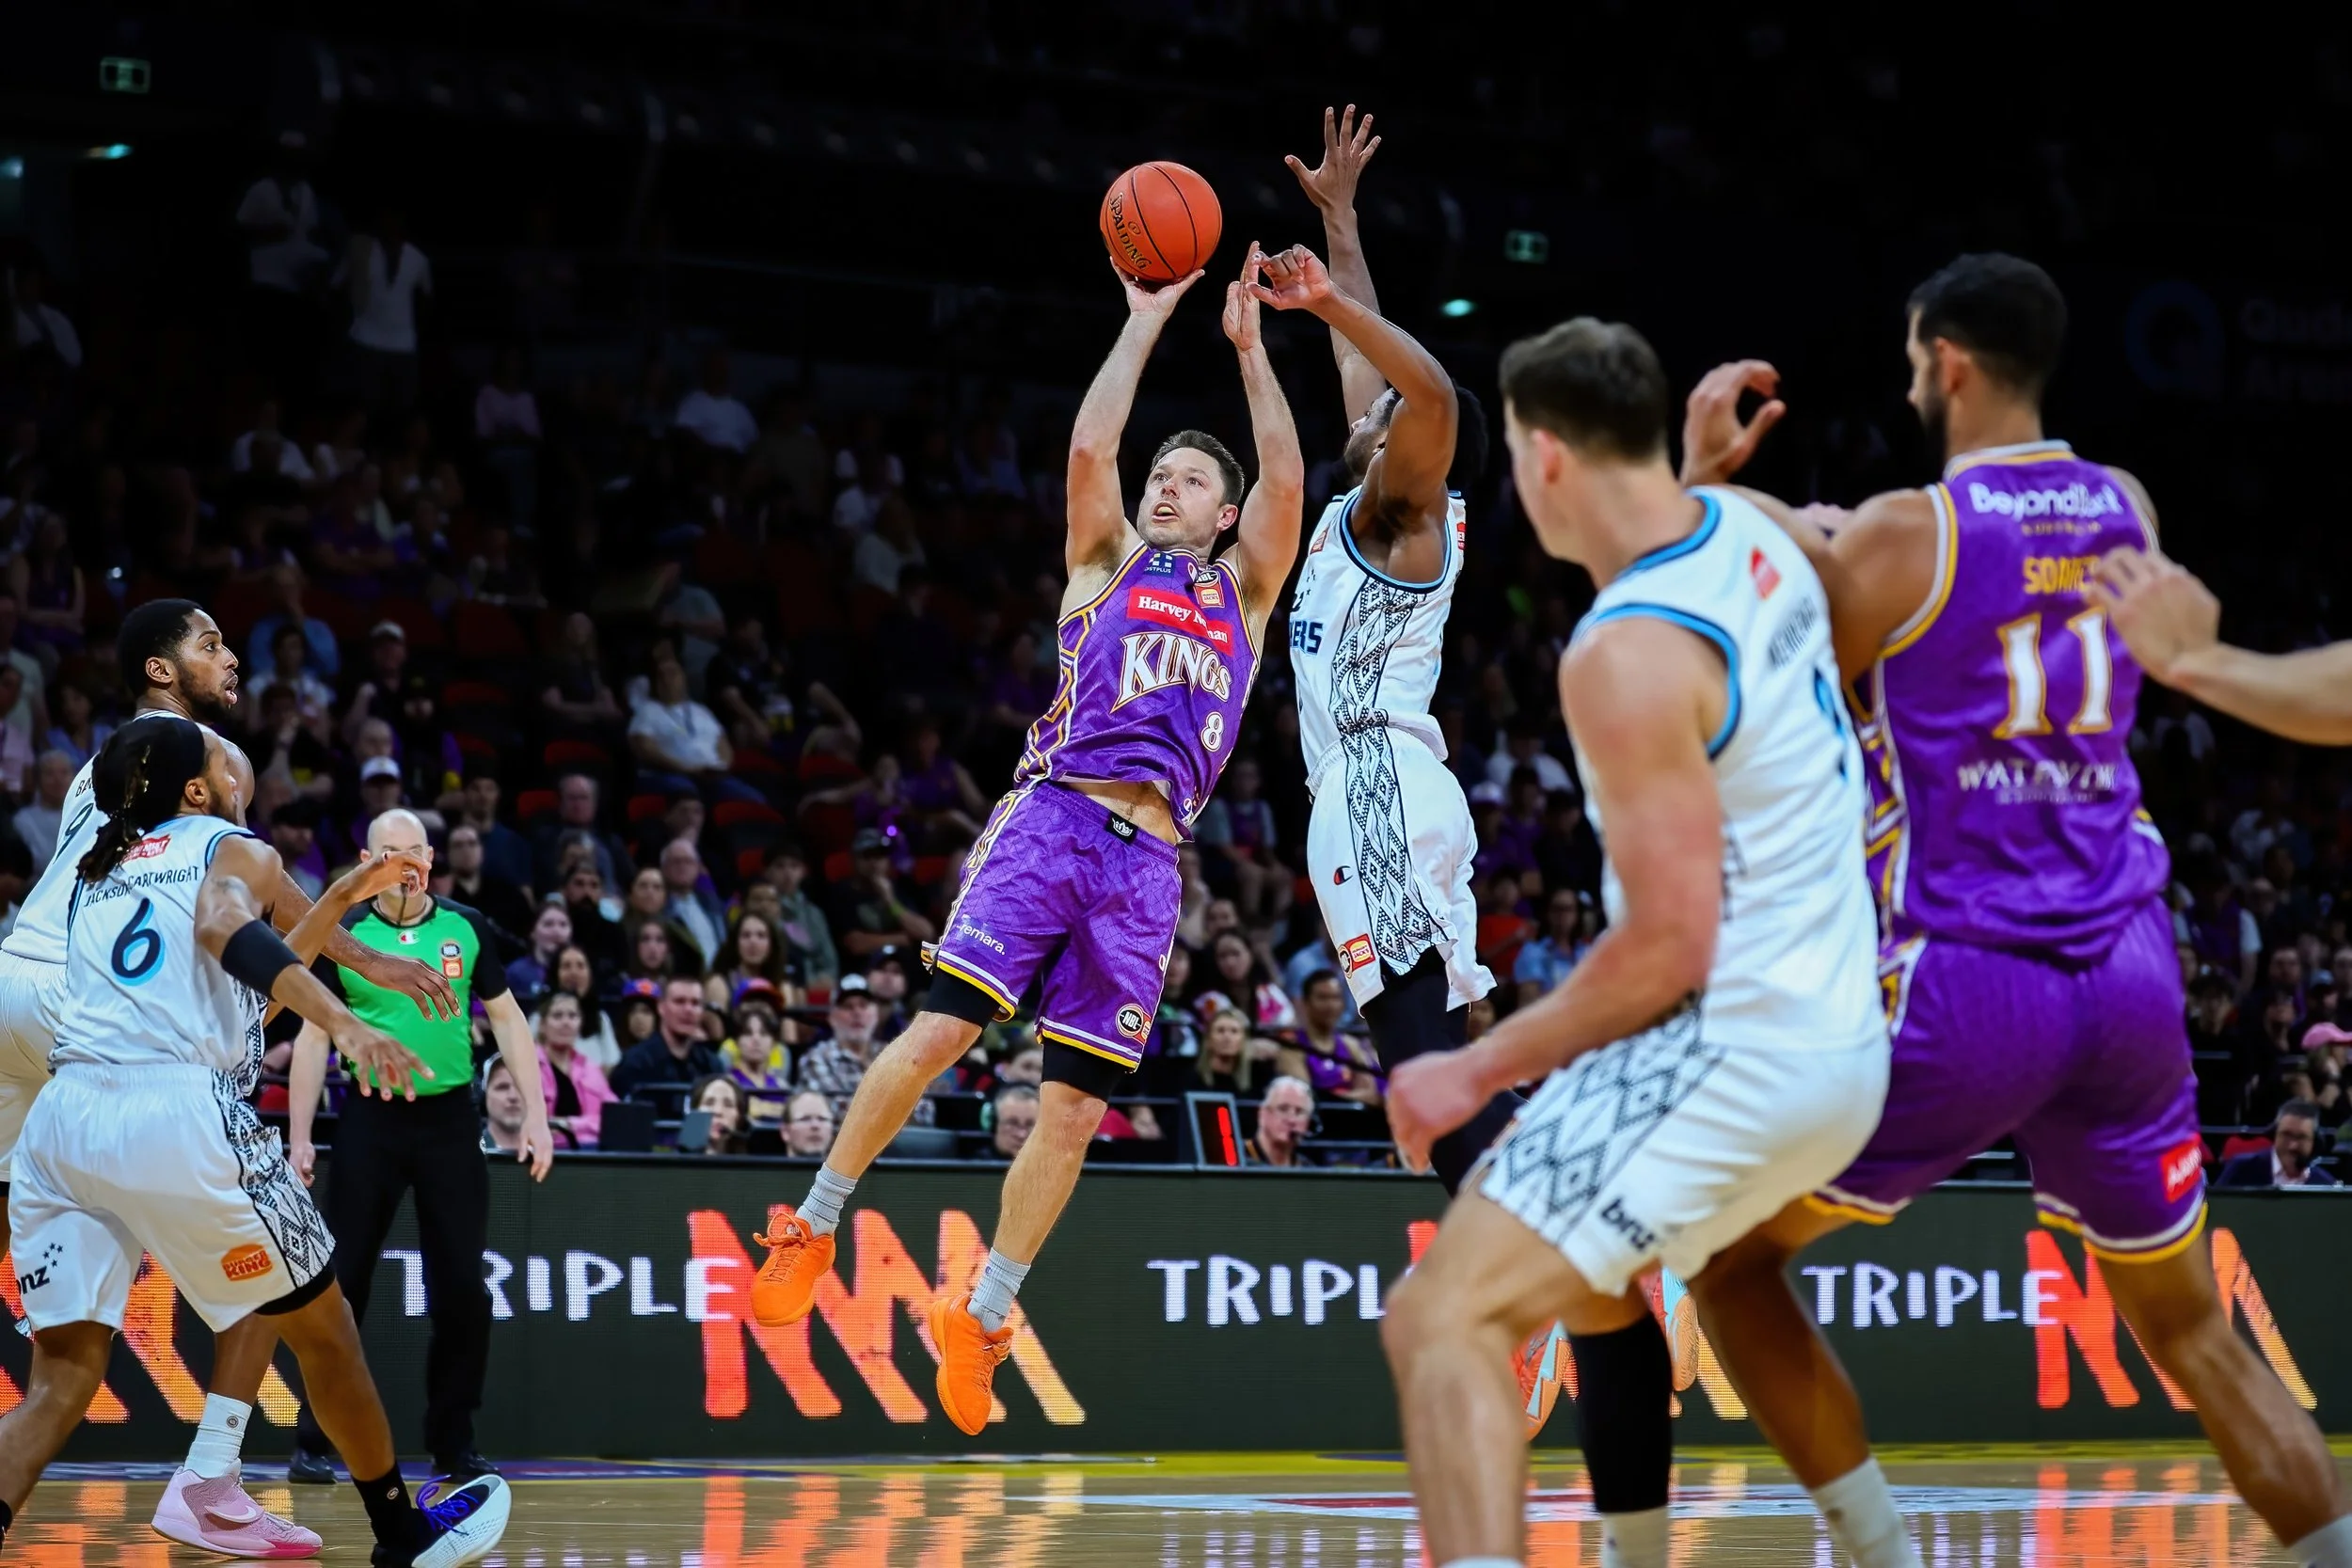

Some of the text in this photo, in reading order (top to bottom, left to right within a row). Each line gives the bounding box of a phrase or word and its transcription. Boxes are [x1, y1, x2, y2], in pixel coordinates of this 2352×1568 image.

[1109, 193, 1152, 270] SPALDING
[1137, 595, 1192, 622] Harvey
[1109, 631, 1232, 715] KINGS
[1992, 606, 2113, 739] 11
[1200, 711, 1224, 752] 8
[54, 802, 94, 861] 9
[111, 896, 166, 986] 6
[1122, 1011, 1140, 1030] NBL
[1146, 1254, 1388, 1326] TRIPL
[1802, 1261, 2062, 1328] TRIPLE
